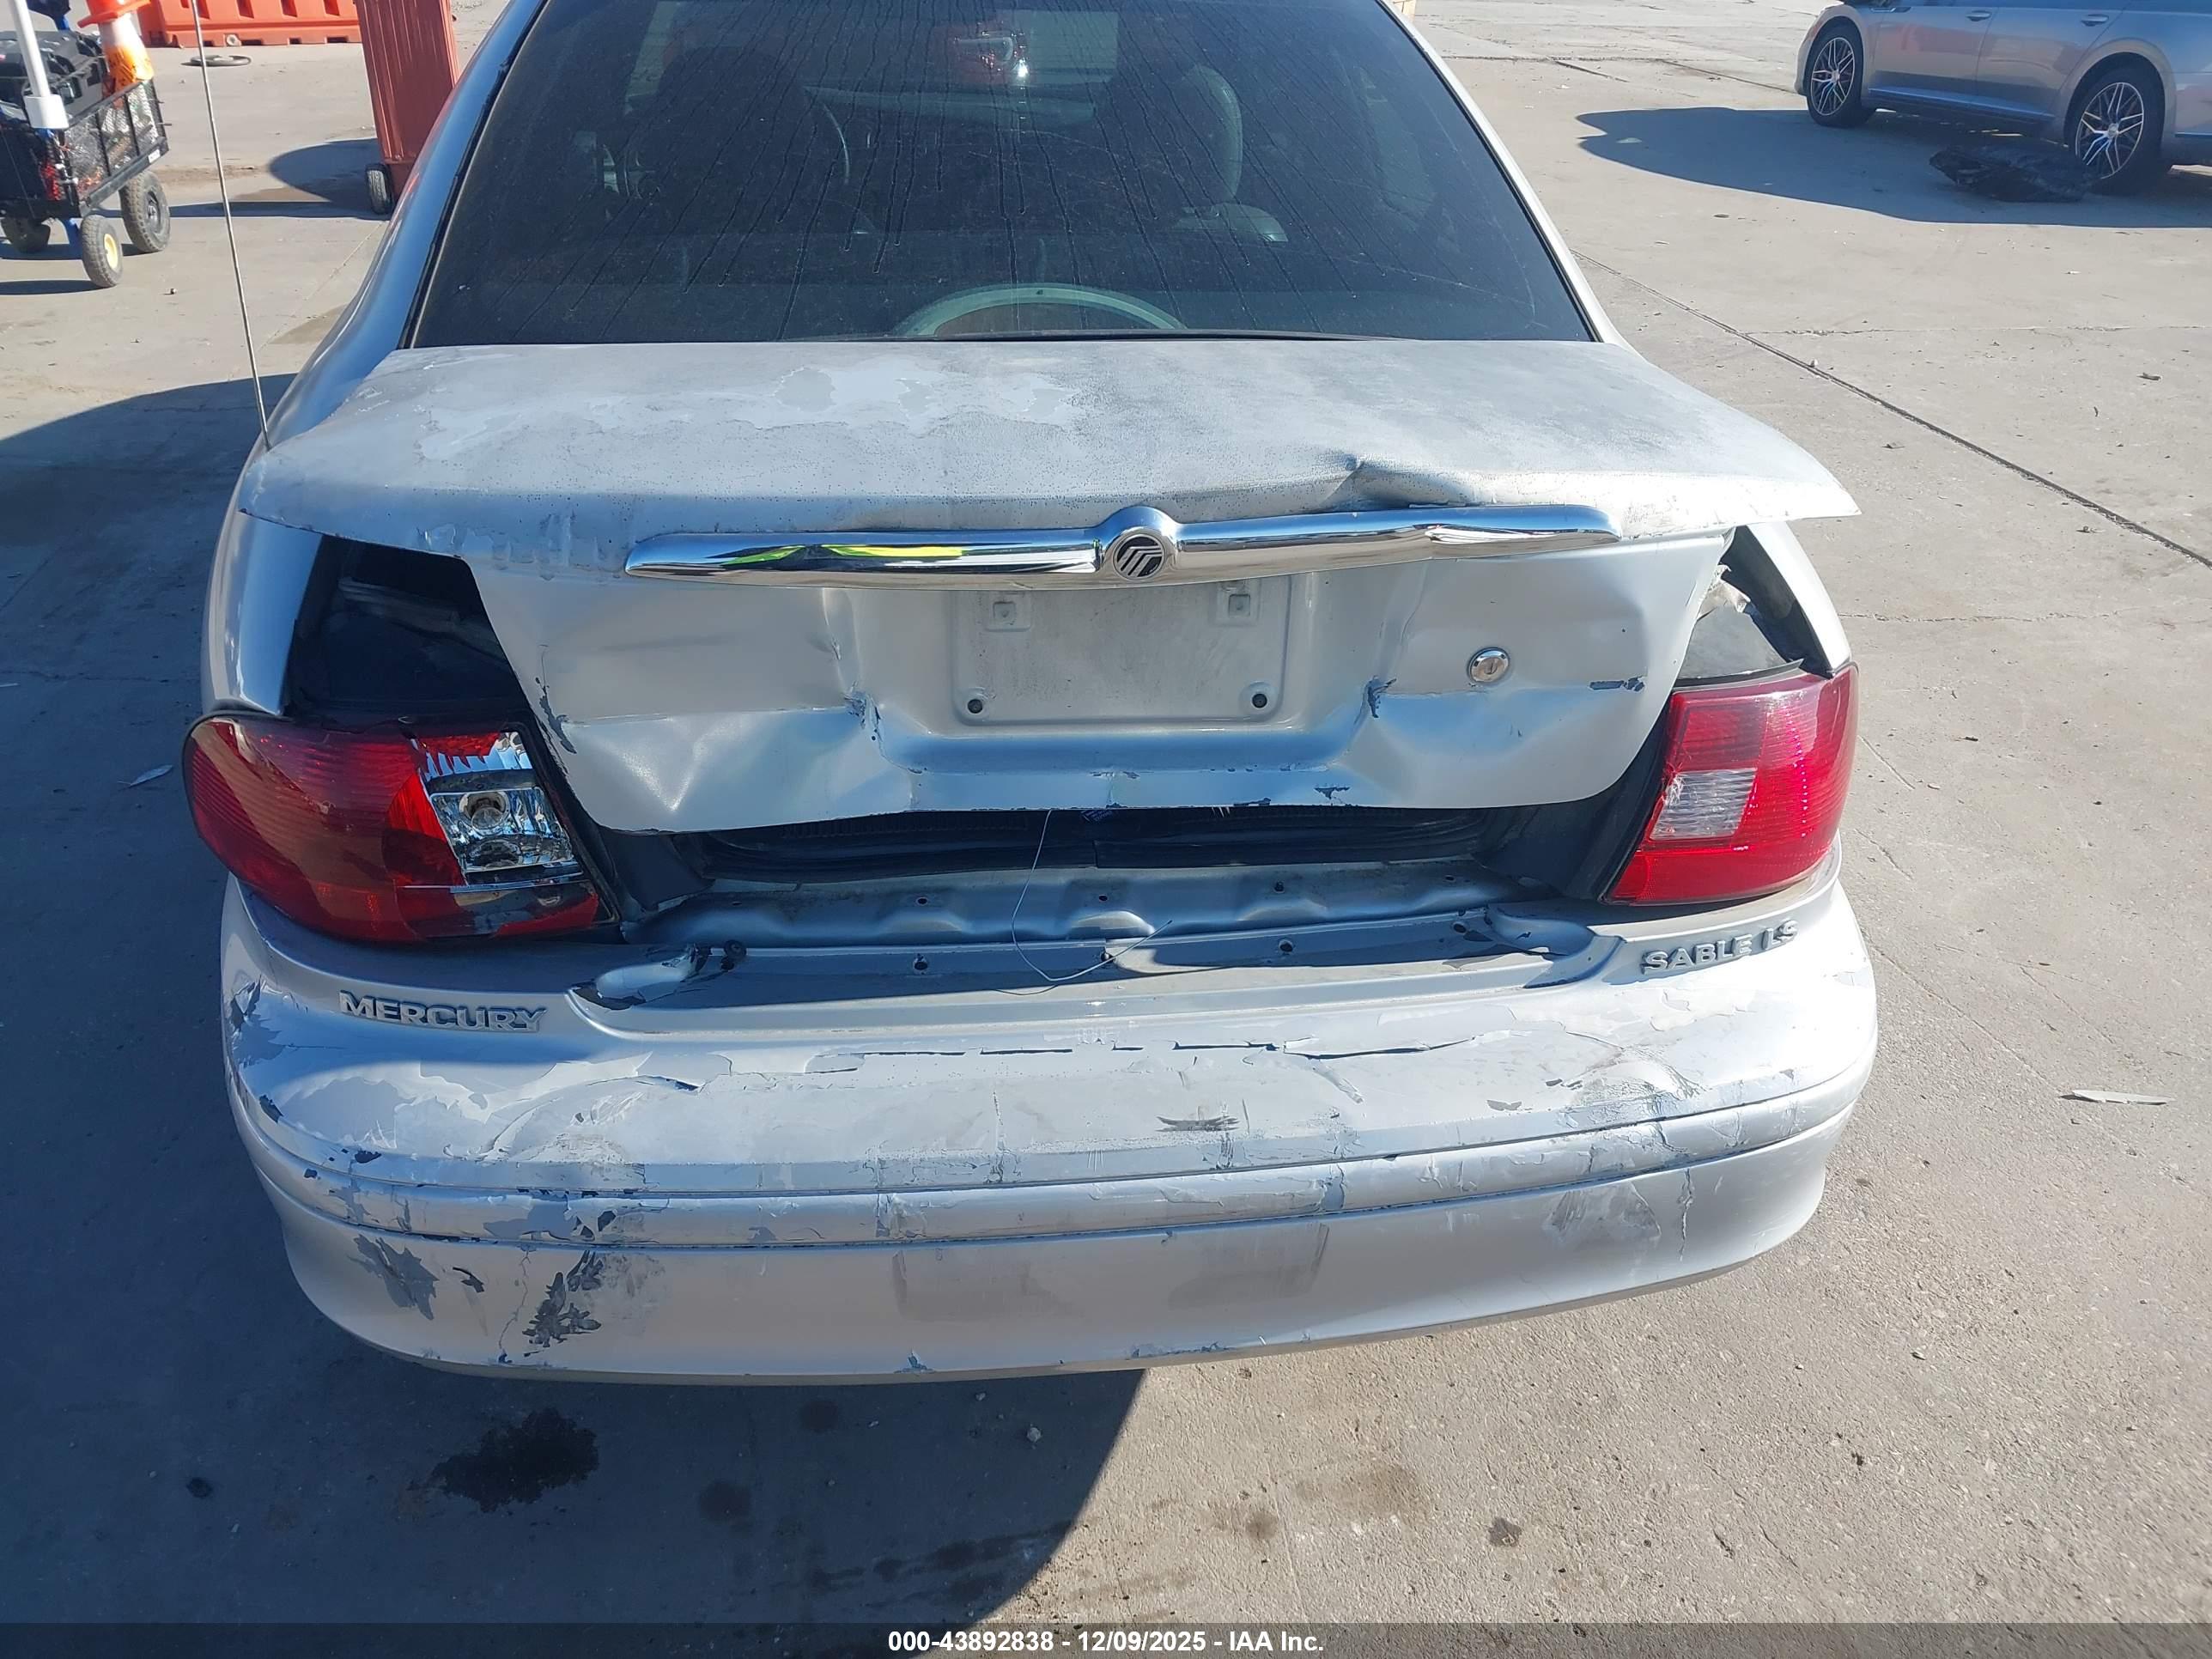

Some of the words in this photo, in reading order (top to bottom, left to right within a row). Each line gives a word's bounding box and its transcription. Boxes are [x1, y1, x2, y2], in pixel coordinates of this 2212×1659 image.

[1641, 934, 1753, 975] SABLE
[1762, 920, 1799, 950] LS
[339, 990, 547, 1032] MERCURY
